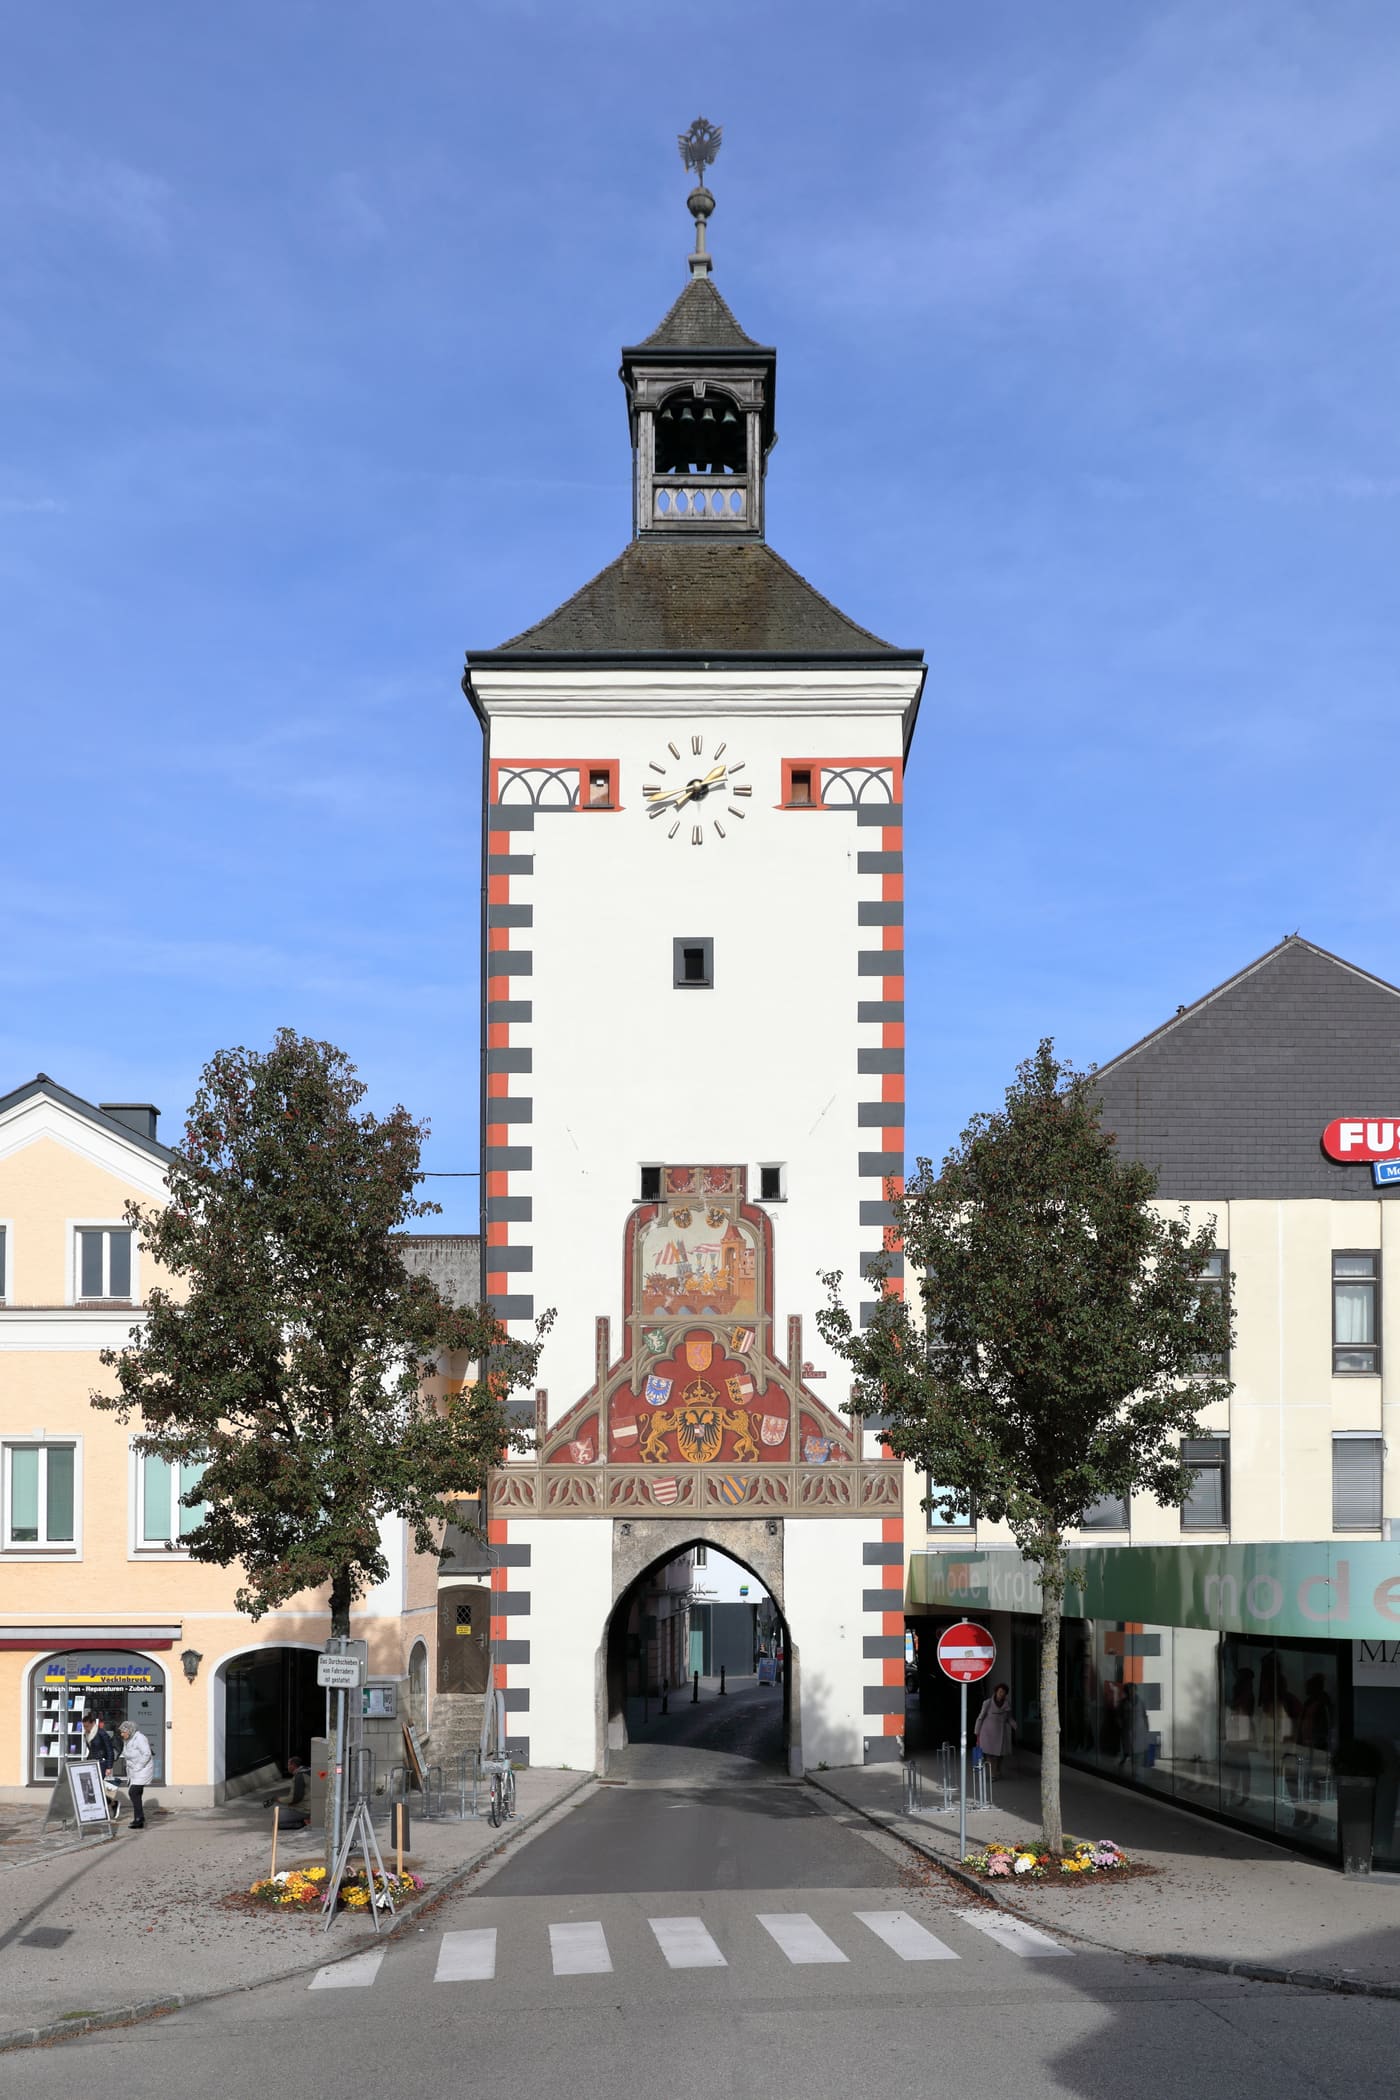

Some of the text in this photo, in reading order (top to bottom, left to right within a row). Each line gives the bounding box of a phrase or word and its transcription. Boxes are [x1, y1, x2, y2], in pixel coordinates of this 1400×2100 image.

[1340, 1122, 1400, 1152] FU
[1204, 1560, 1400, 1623] mode
[47, 1664, 151, 1678] Hadycenter
